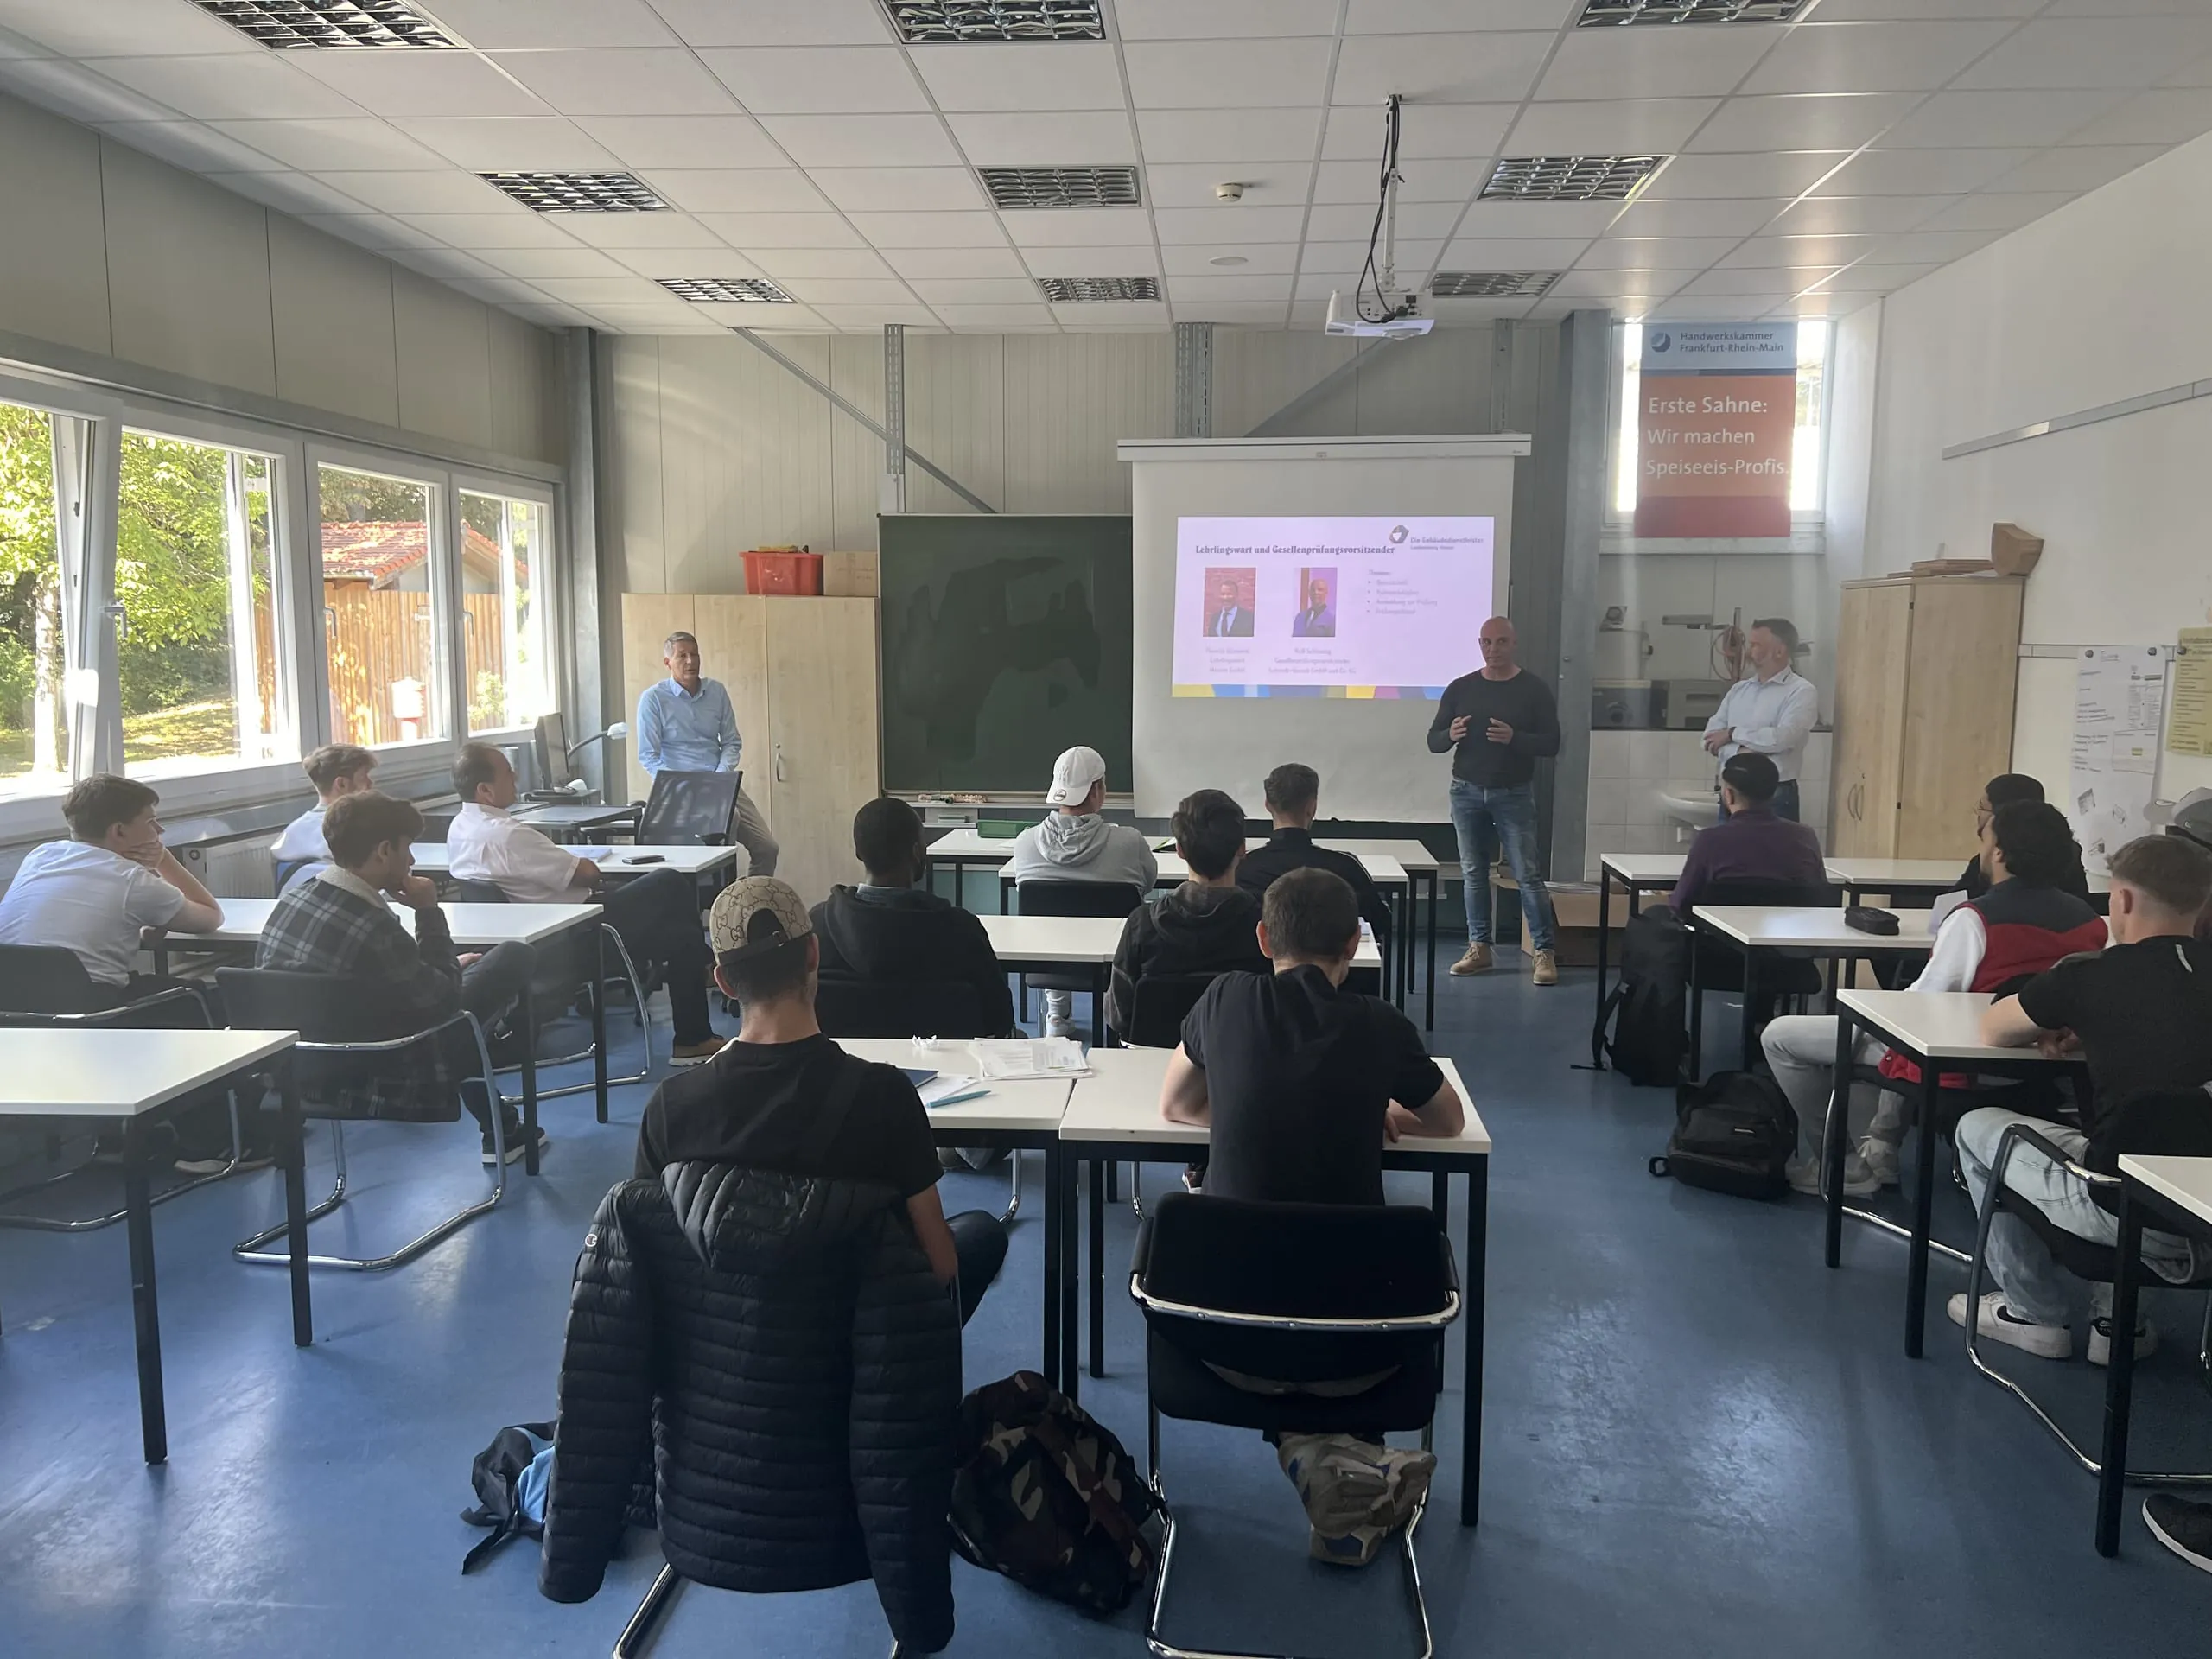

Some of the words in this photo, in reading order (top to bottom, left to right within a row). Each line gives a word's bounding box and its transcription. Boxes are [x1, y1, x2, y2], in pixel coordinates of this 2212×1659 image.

[1680, 332, 1774, 341] Handwerkskammer
[1680, 343, 1784, 353] Frankfurt-Rhein-Main
[1648, 397, 1697, 414] Erste
[1701, 397, 1768, 414] Sahne:
[1647, 429, 1679, 444] Wir
[1684, 428, 1755, 444] machen
[1645, 458, 1789, 478] Speiseeis-Profis.
[1195, 545, 1252, 556] Lehrlingswart
[1254, 545, 1270, 554] und
[1272, 544, 1395, 556] Gesellenprüfungsvorsitzender
